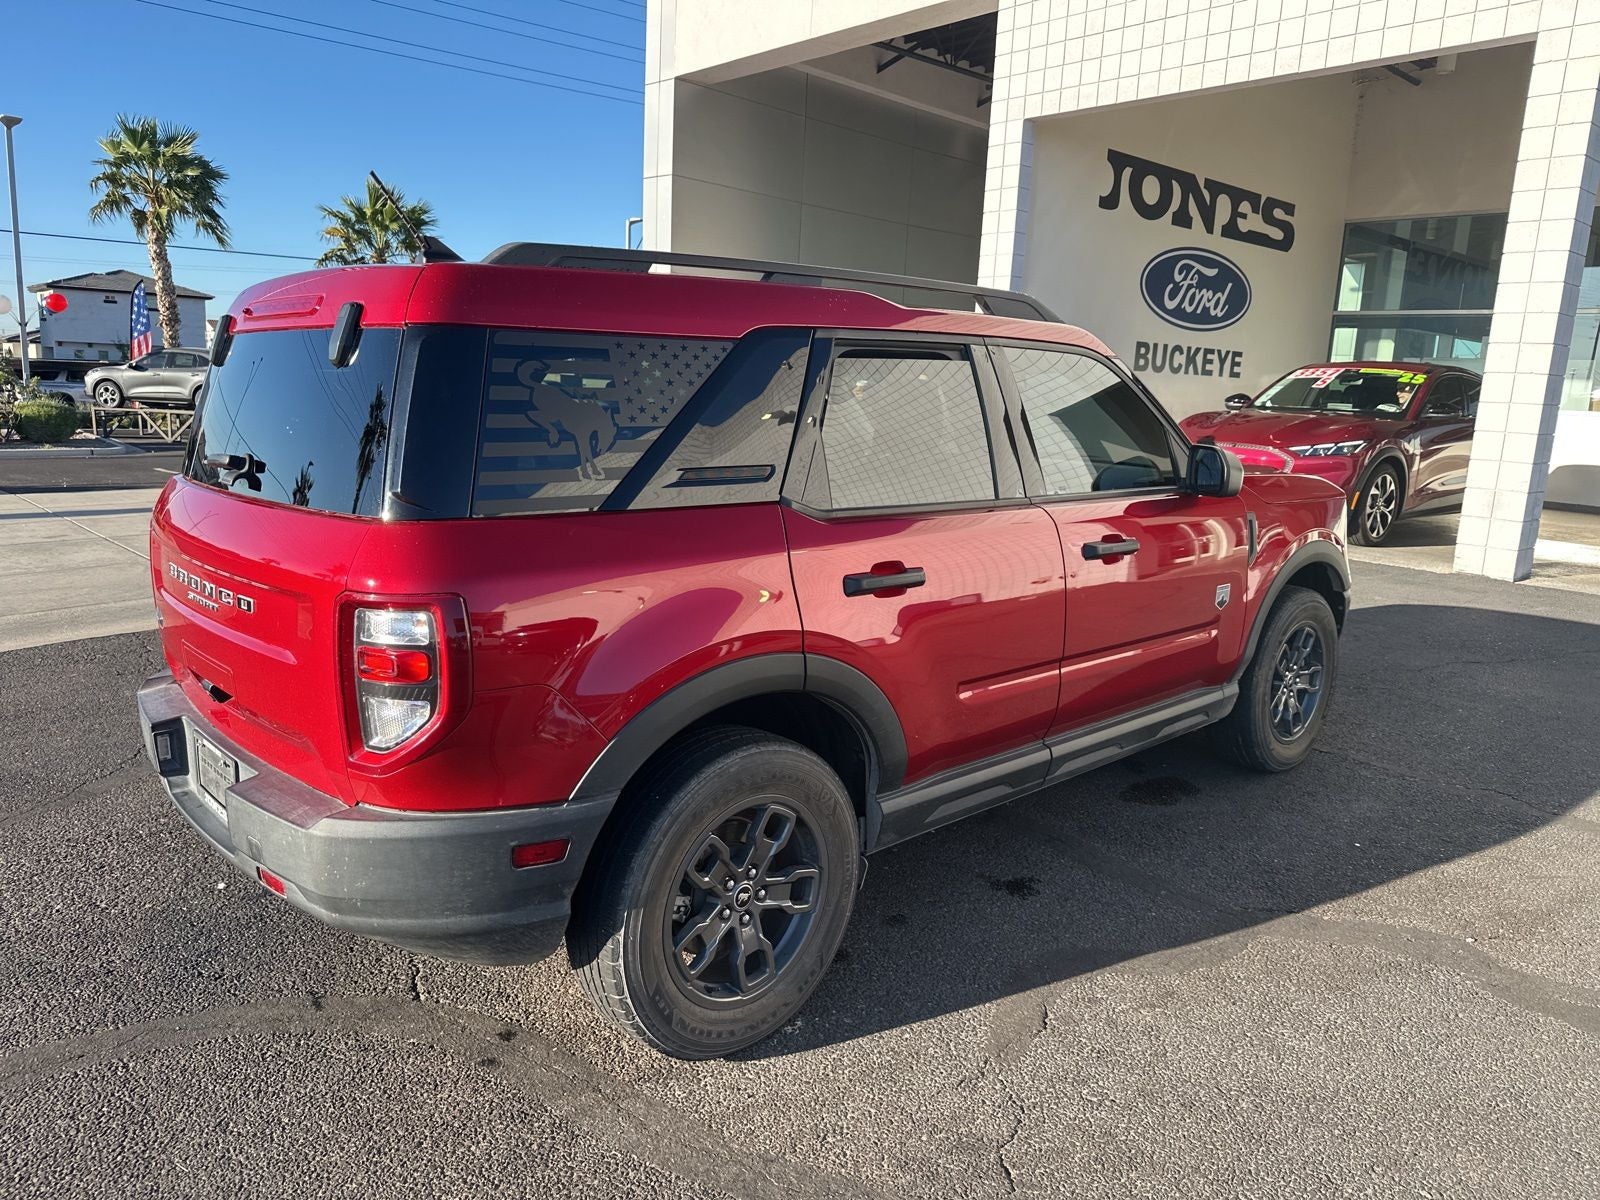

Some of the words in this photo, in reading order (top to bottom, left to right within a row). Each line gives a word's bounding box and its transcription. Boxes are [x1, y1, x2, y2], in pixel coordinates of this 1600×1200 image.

[1098, 148, 1296, 253] JONES
[1163, 258, 1233, 318] Ford
[1133, 341, 1243, 379] BUCKEYE
[1397, 372, 1428, 385] 25
[168, 562, 255, 614] BRONCO
